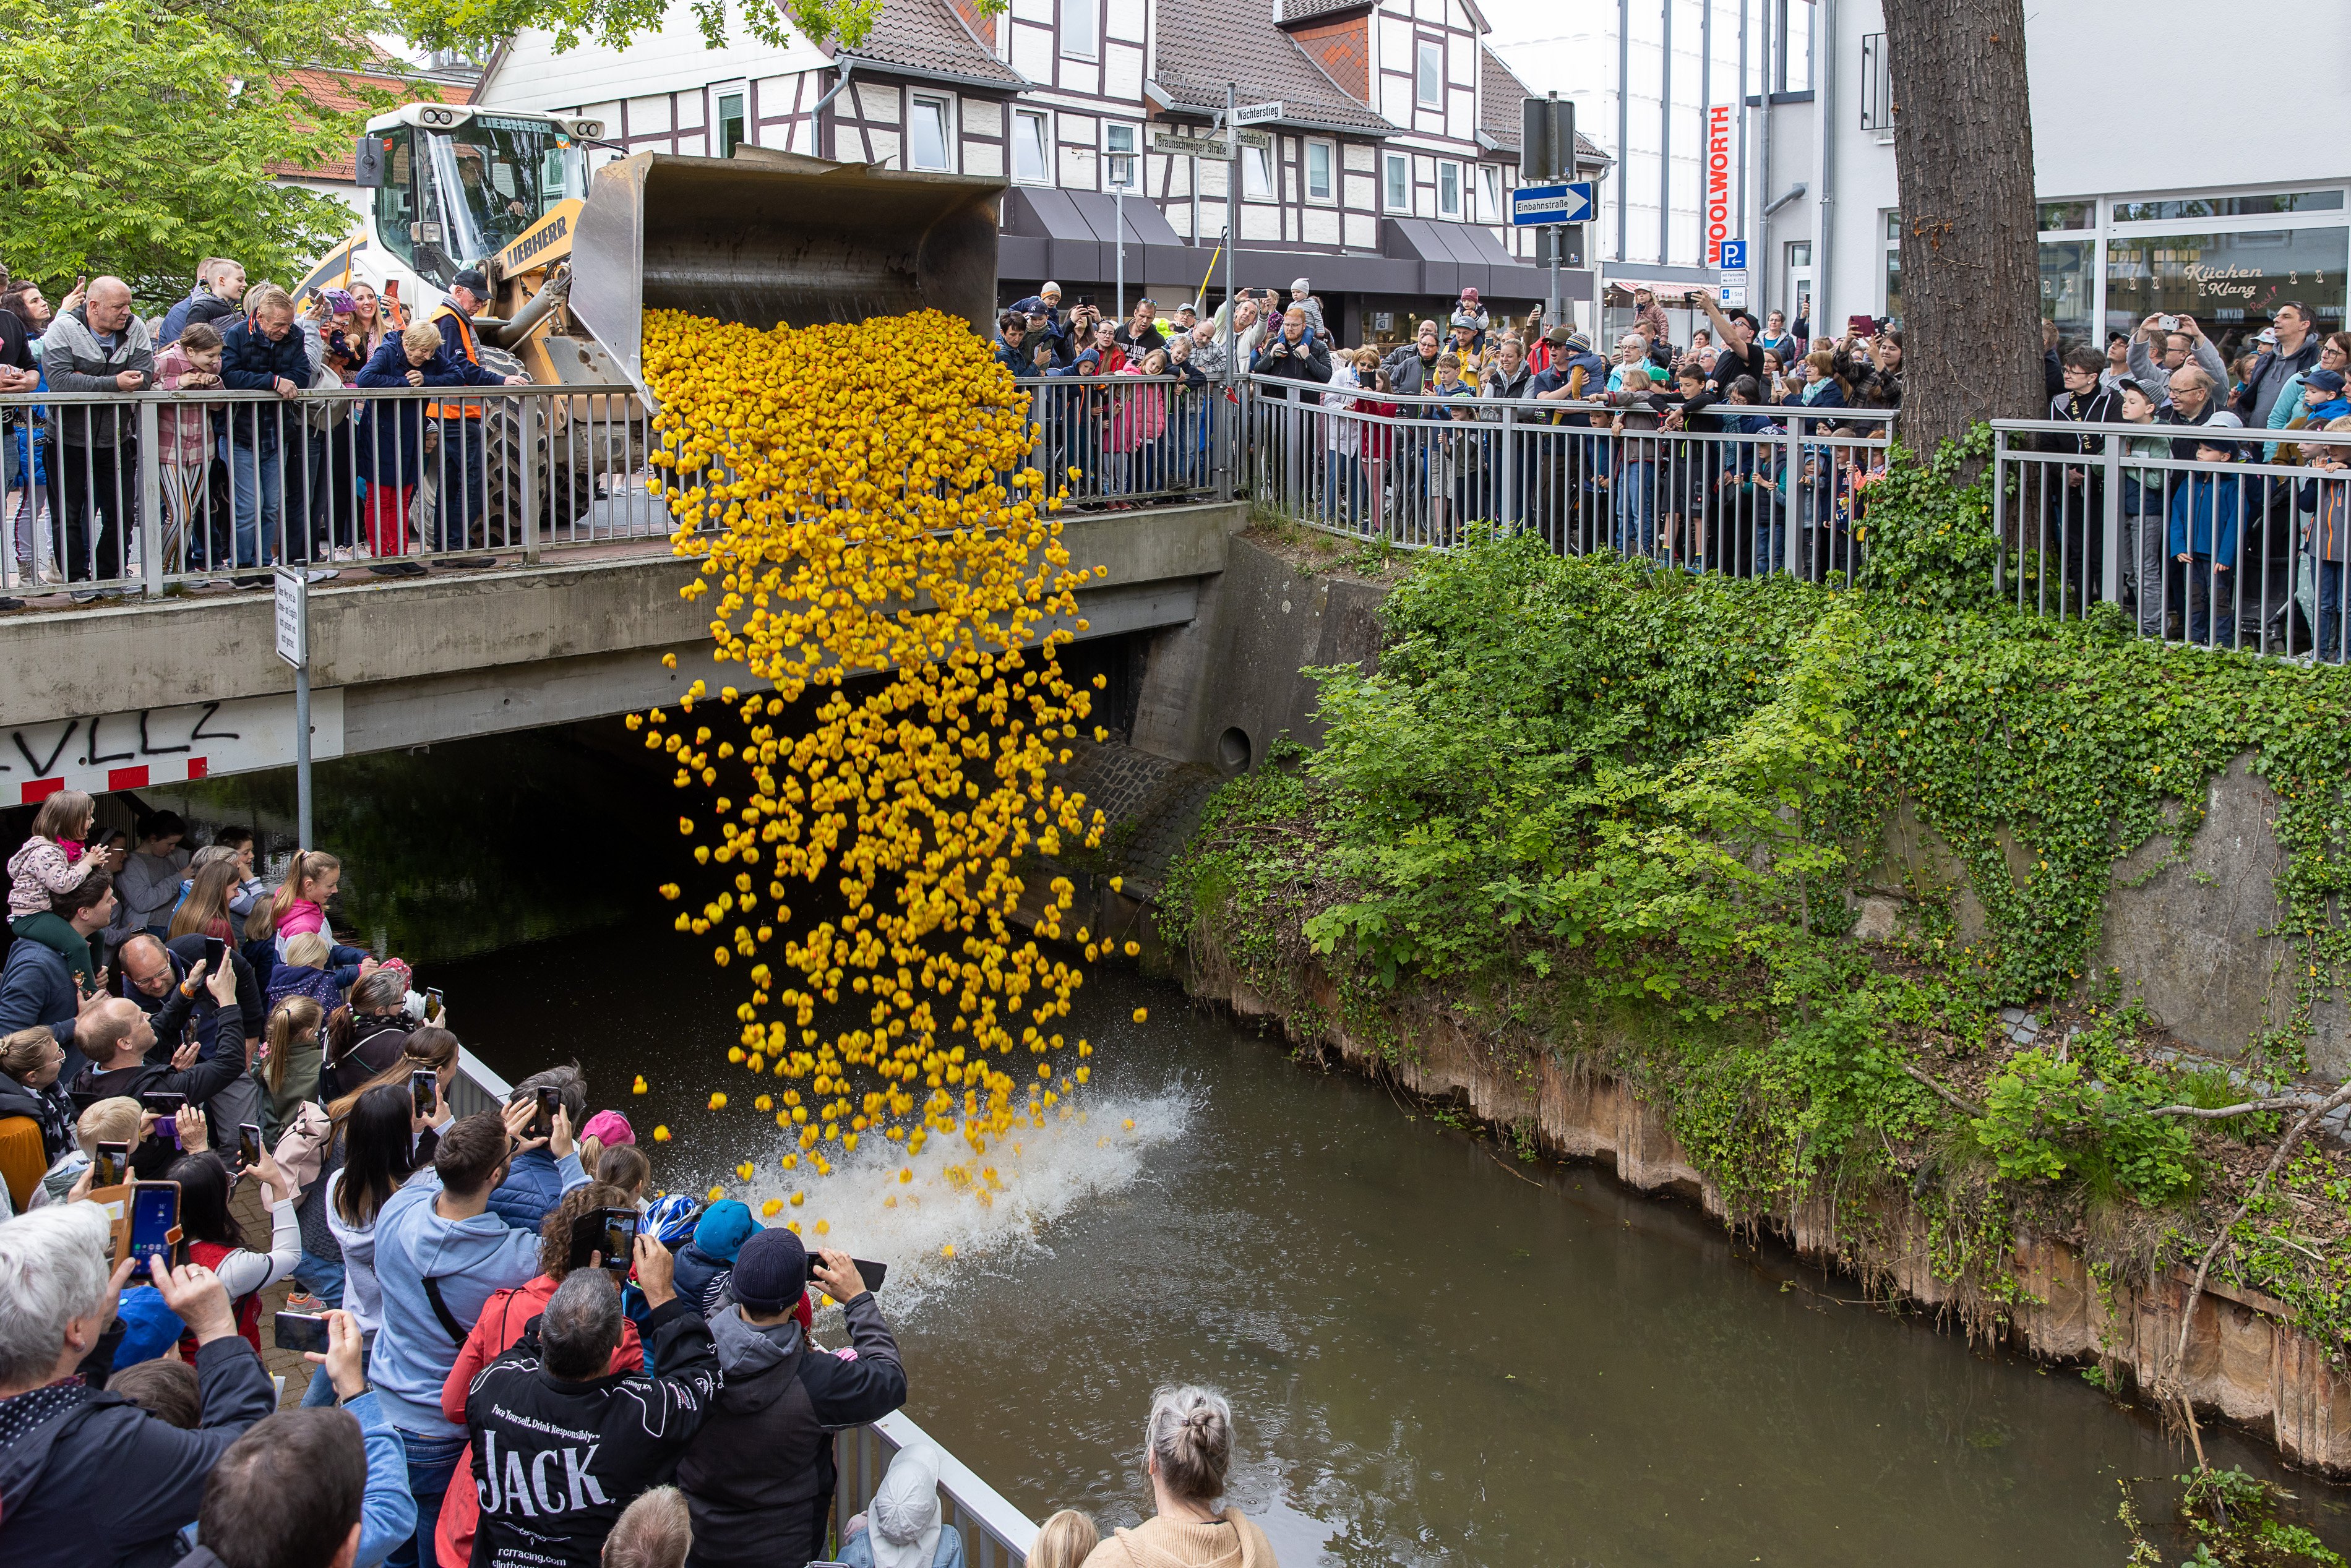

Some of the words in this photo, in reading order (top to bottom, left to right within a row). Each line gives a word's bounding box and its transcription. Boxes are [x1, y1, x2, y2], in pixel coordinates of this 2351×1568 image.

[1237, 106, 1278, 121] Wächterstieg
[477, 117, 553, 134] LIEBHERR
[1158, 135, 1205, 155] Braunschweiger
[1208, 142, 1226, 155] Straße
[1237, 131, 1266, 146] Poststraße
[1709, 106, 1729, 263] WOOLWORTH
[1518, 199, 1568, 212] Einbahnstraße
[507, 216, 567, 270] LIEBHERR
[1724, 244, 1739, 266] P
[2183, 263, 2263, 282] Küchen
[2208, 282, 2256, 299] Klang
[2071, 400, 2079, 415] FILA
[492, 1403, 506, 1418] Pace
[531, 1419, 551, 1433] Drink
[476, 1429, 610, 1516] JACK
[498, 1548, 566, 1566] rcrracing.com
